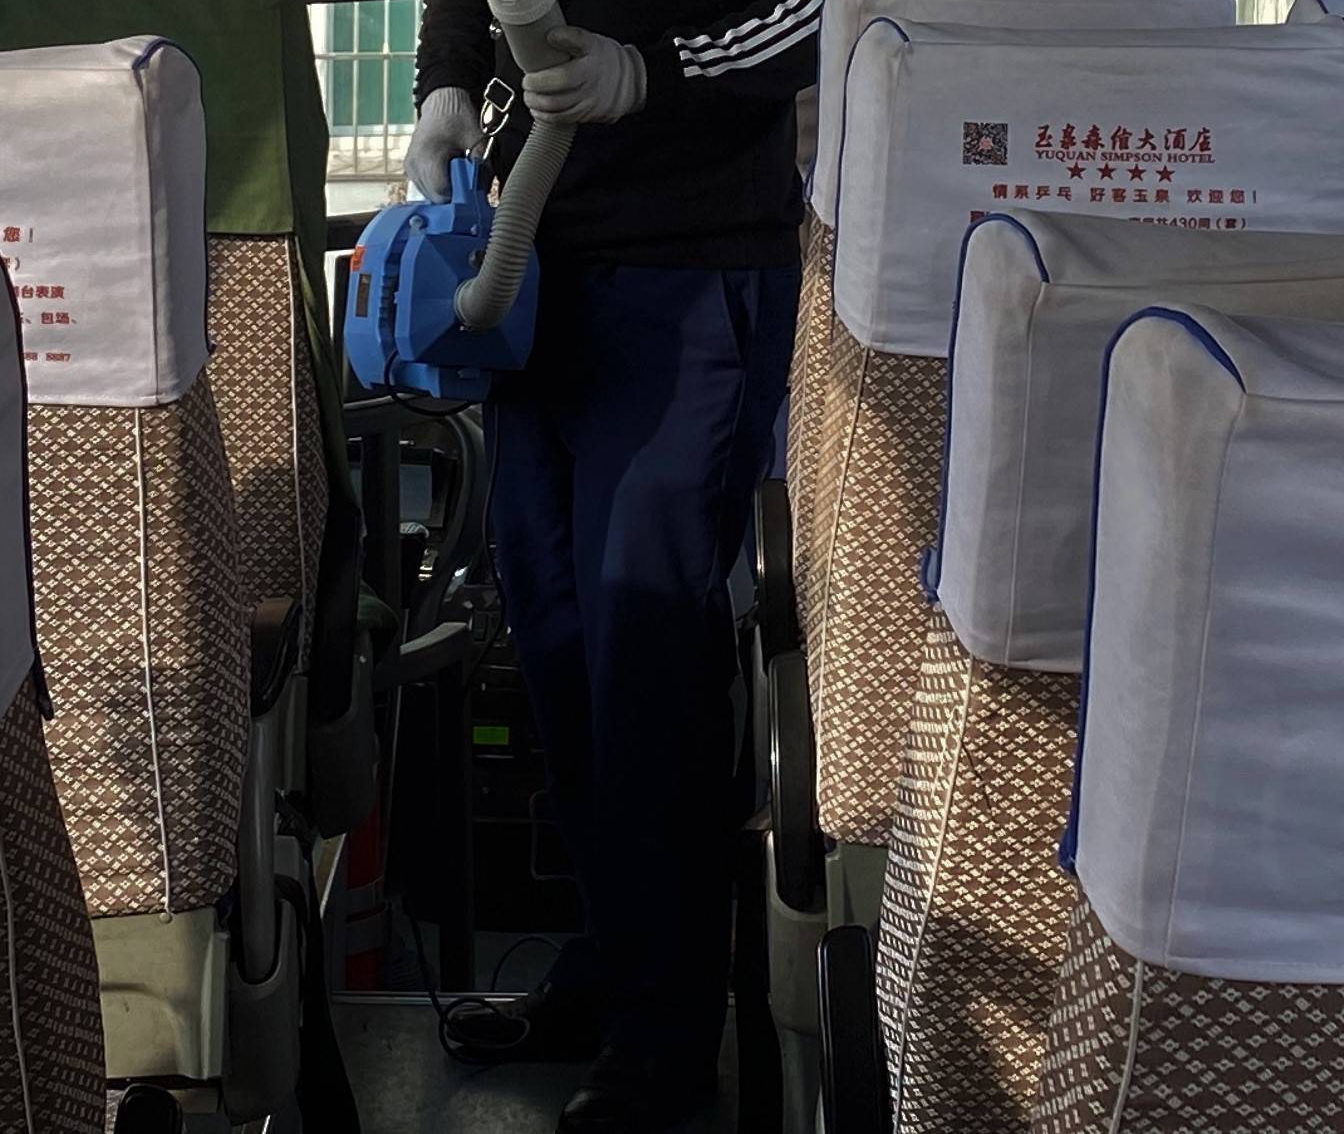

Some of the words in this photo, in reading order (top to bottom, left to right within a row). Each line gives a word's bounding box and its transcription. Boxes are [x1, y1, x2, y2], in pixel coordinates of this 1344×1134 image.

[1034, 122, 1212, 151] 玉泉森信大酒店
[1035, 150, 1096, 163] YUQUAN
[1100, 151, 1163, 164] SIMPSON
[1167, 152, 1216, 164] HOTEL
[993, 184, 1072, 201] 情系乒乓
[1090, 188, 1168, 202] 好客玉泉
[20, 311, 80, 326] 、包场、
